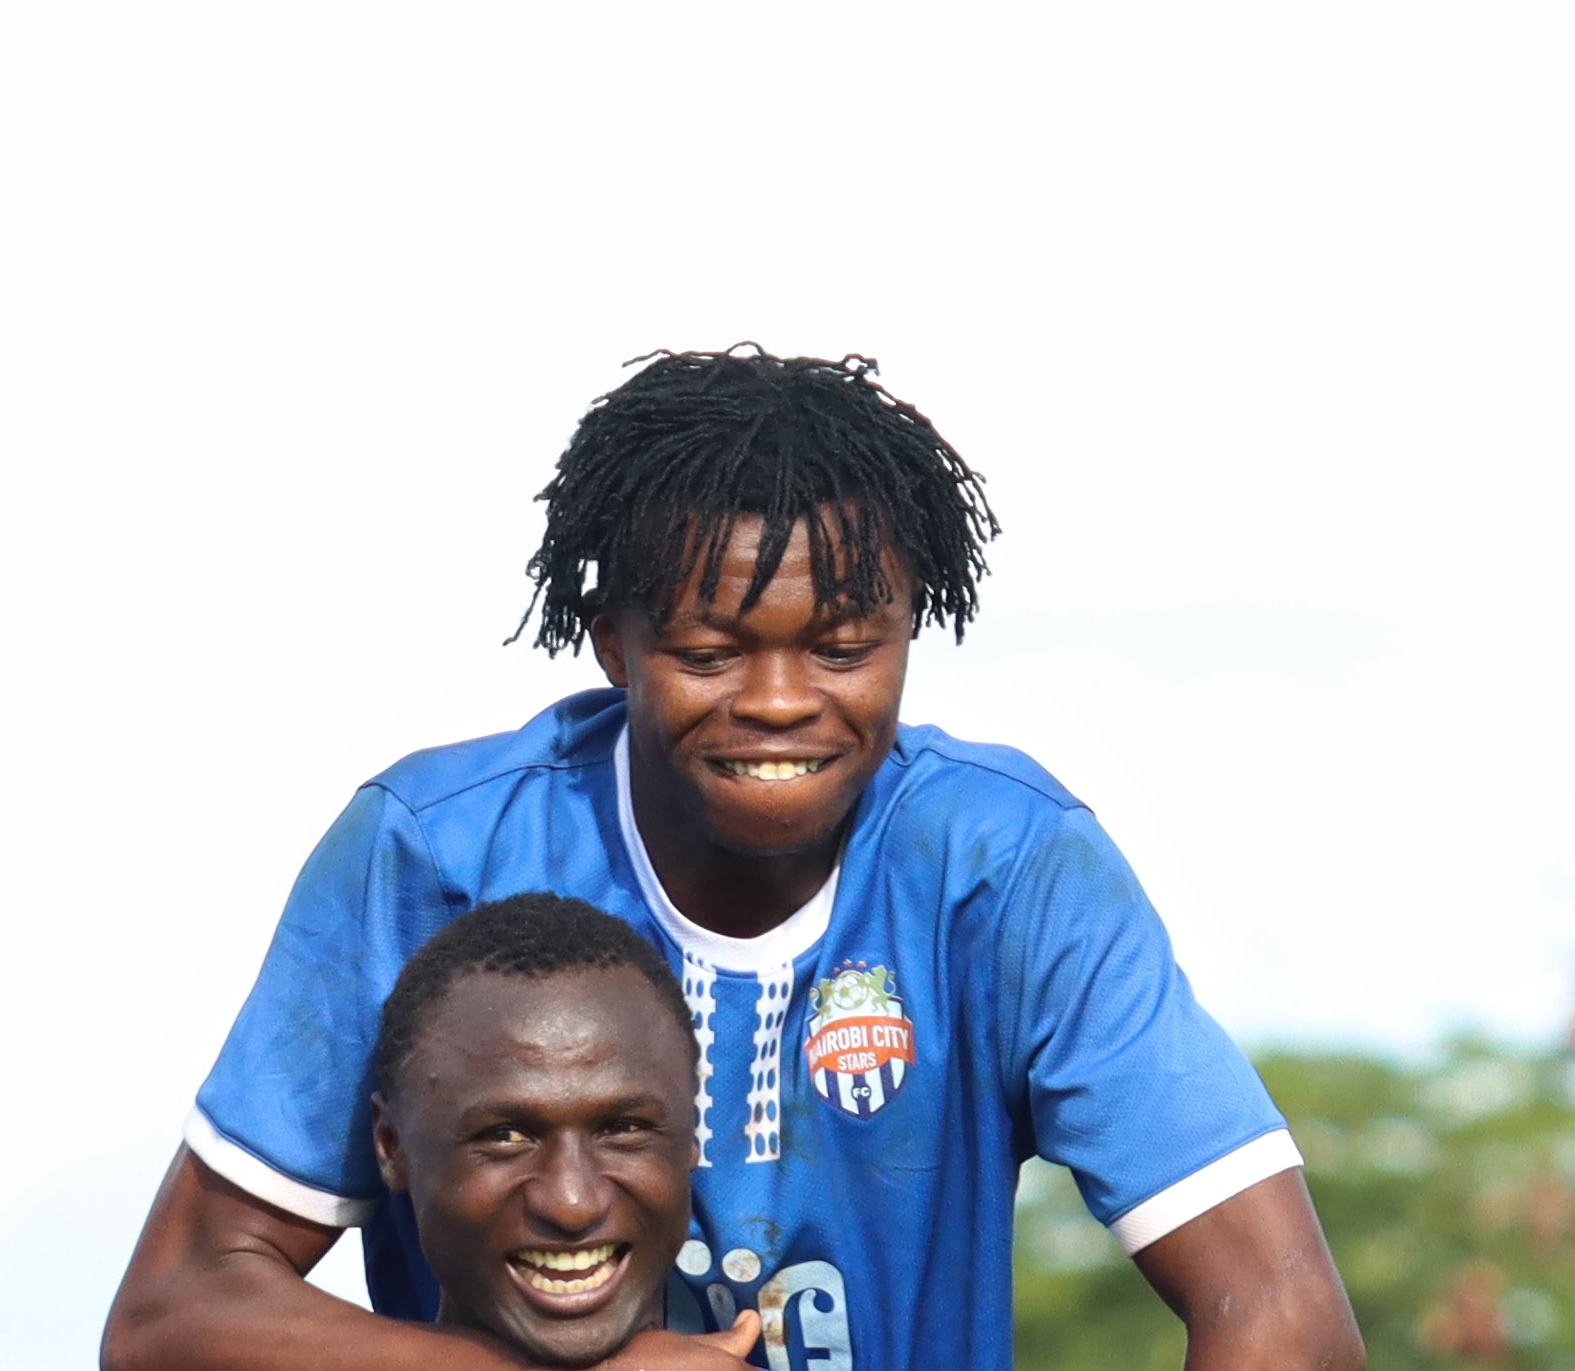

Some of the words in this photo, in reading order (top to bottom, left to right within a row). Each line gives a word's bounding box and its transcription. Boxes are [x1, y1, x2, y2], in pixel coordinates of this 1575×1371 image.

[809, 1025, 868, 1062] NAIROBI
[872, 1025, 909, 1050] CITY
[837, 1052, 877, 1071] STARS
[852, 1086, 870, 1098] FC
